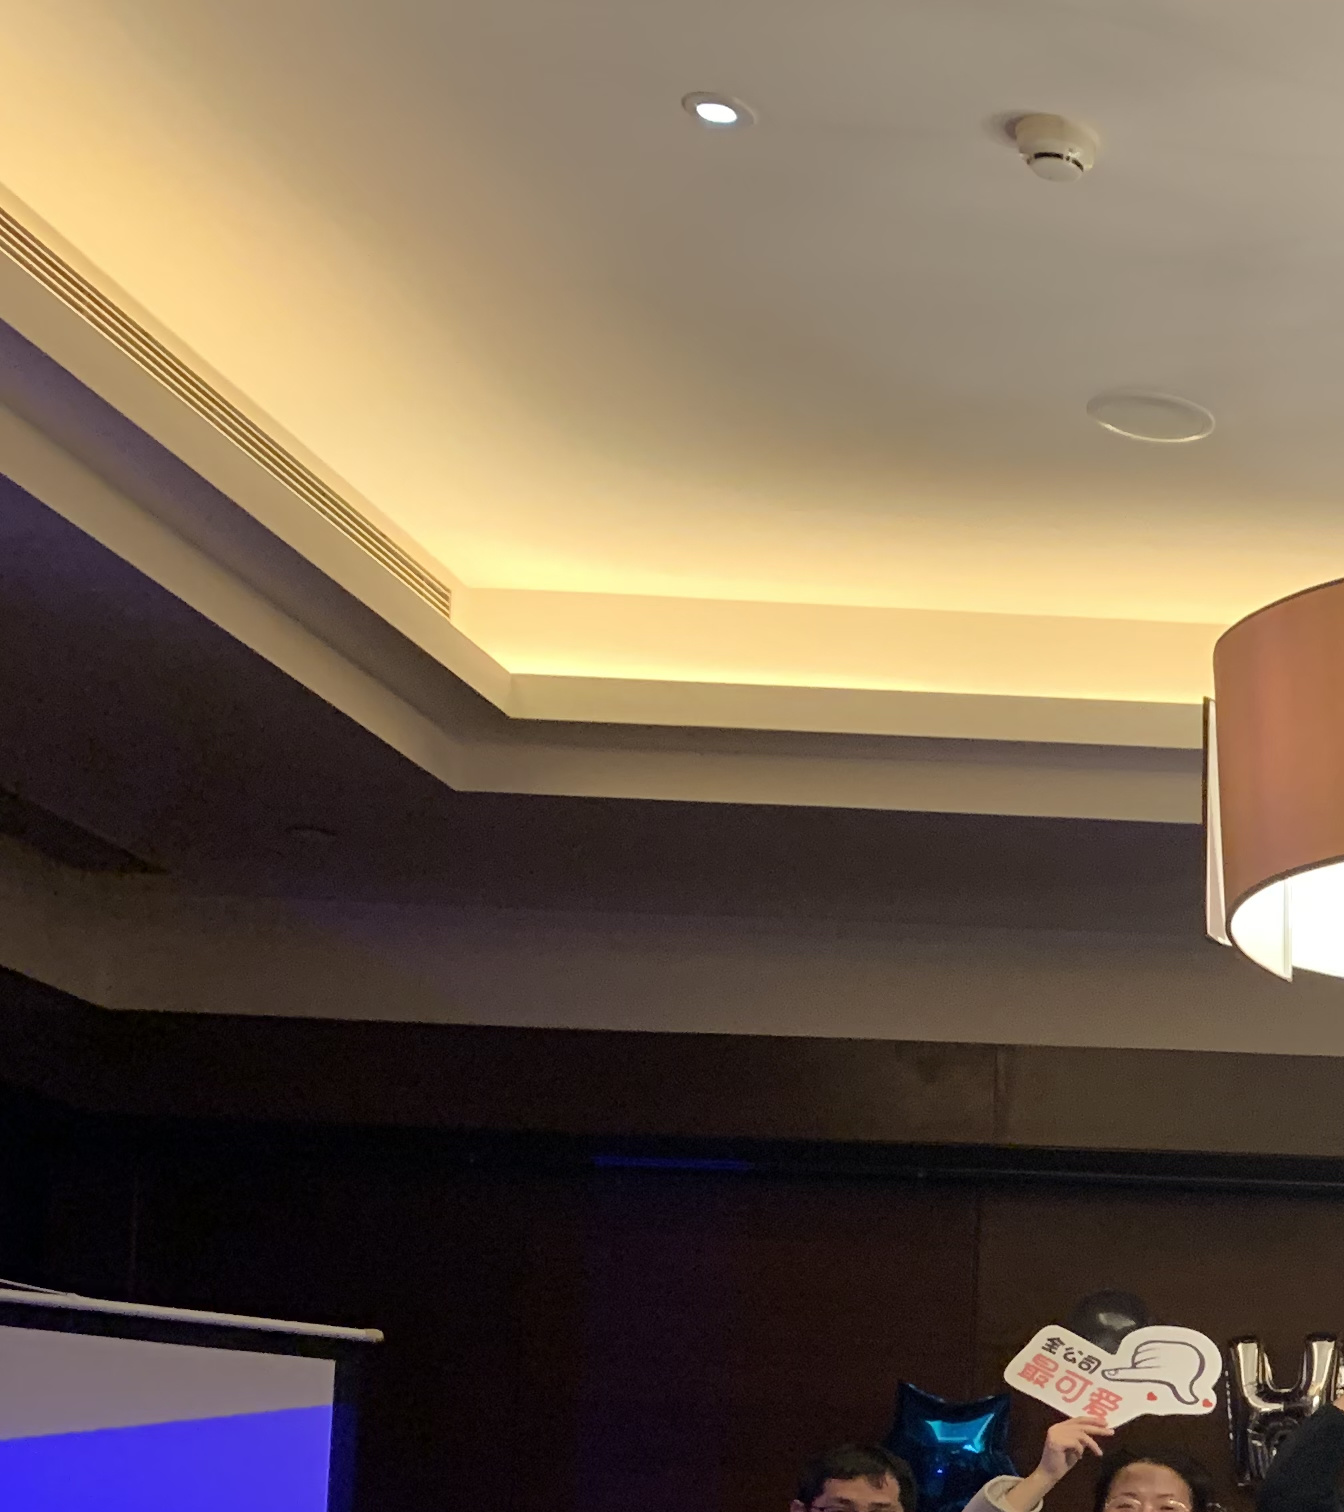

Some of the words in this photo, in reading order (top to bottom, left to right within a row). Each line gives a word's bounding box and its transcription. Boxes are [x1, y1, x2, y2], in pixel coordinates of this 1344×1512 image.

[1041, 1337, 1102, 1375] 全公司
[1017, 1354, 1123, 1428] 最可爱
